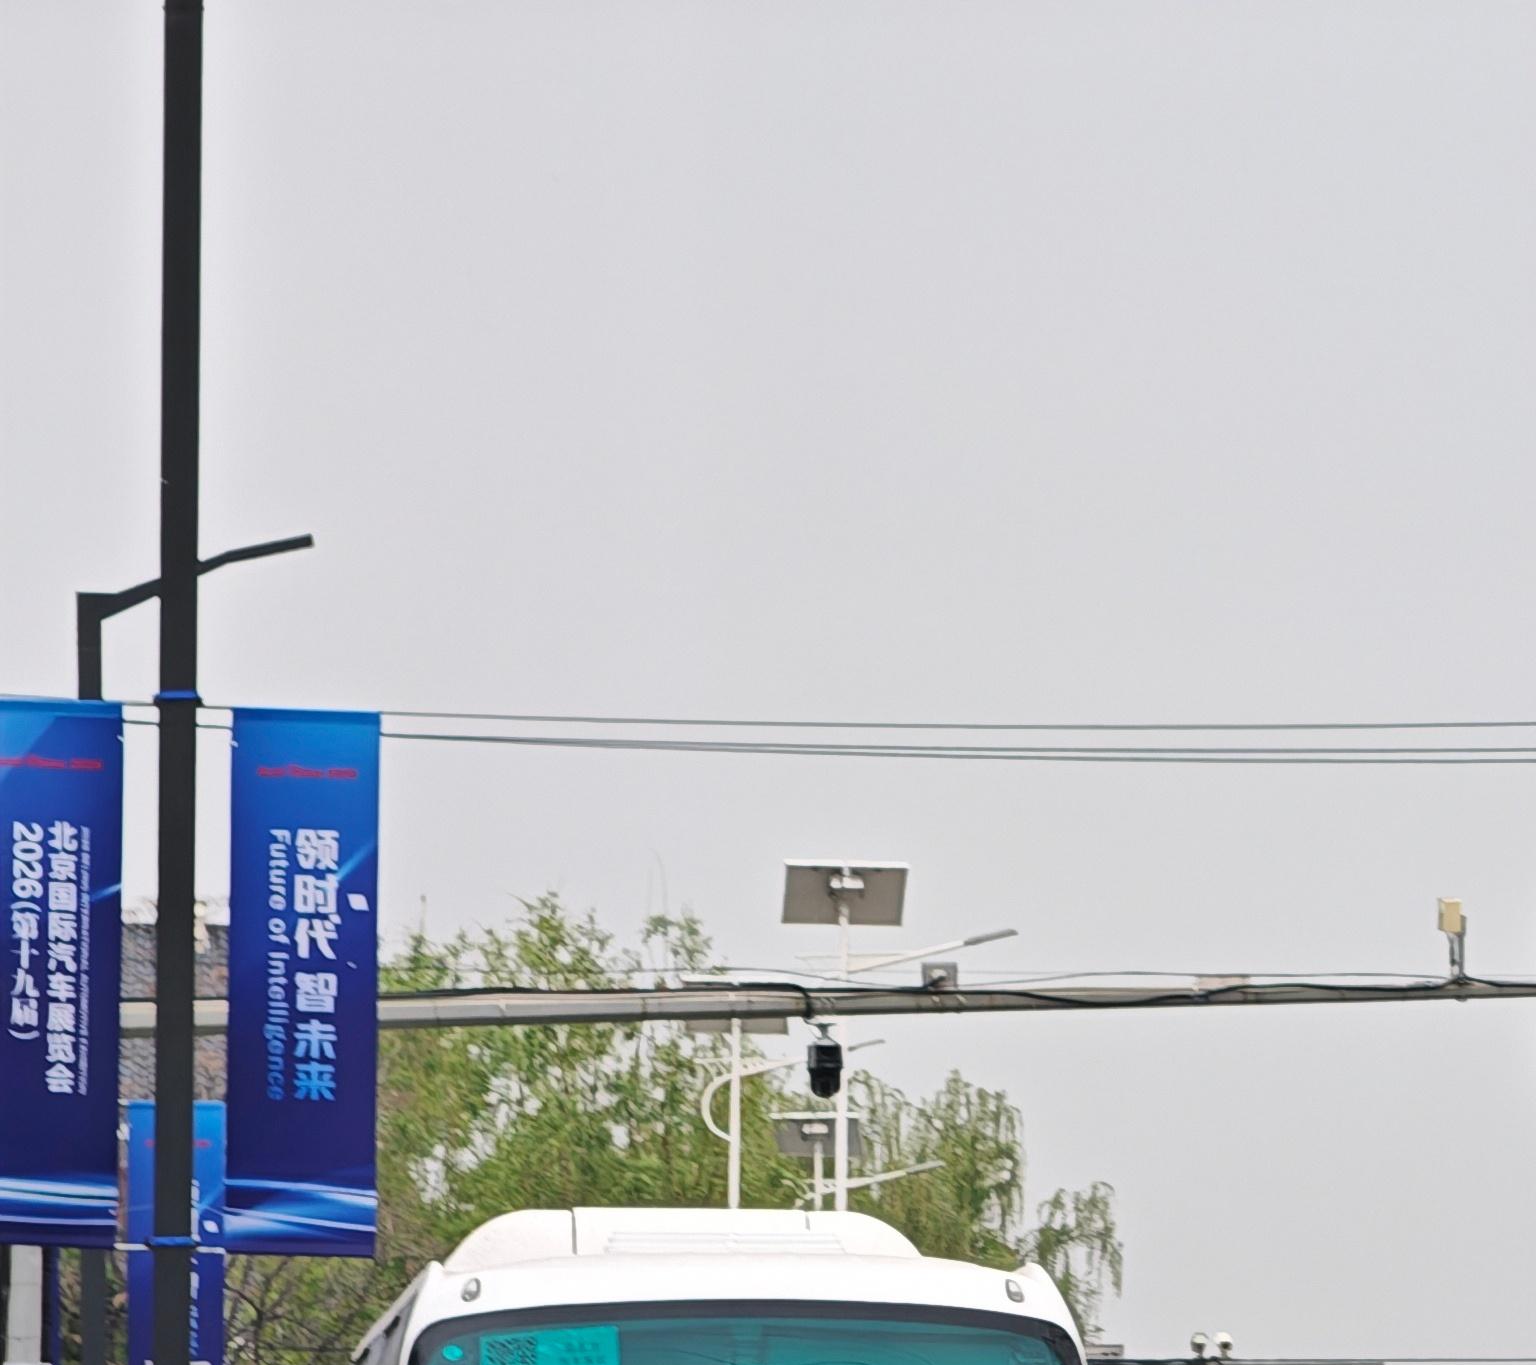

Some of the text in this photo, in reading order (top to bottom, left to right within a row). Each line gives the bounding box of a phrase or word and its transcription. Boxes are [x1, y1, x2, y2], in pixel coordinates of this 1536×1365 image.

[45, 821, 78, 1094] 北京国际汽车展览会
[263, 829, 292, 1100] Future of Intelligence
[294, 828, 342, 960] 领时代
[293, 972, 338, 1100] 智未来
